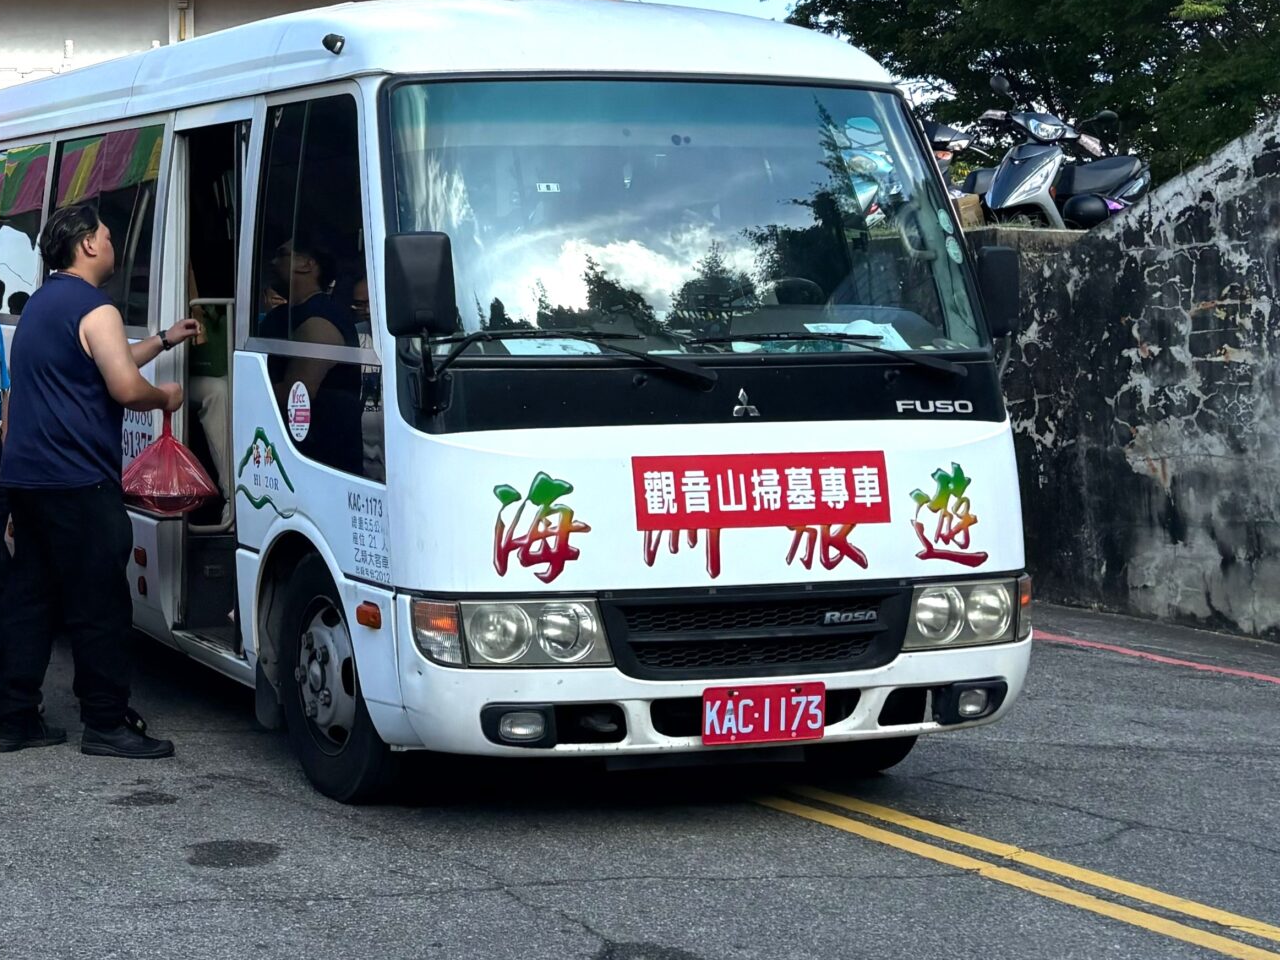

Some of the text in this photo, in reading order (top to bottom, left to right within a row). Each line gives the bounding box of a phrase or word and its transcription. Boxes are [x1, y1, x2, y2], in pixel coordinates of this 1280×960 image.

[896, 399, 973, 414] FUSO
[643, 465, 882, 515] 觀音山掃墓專車
